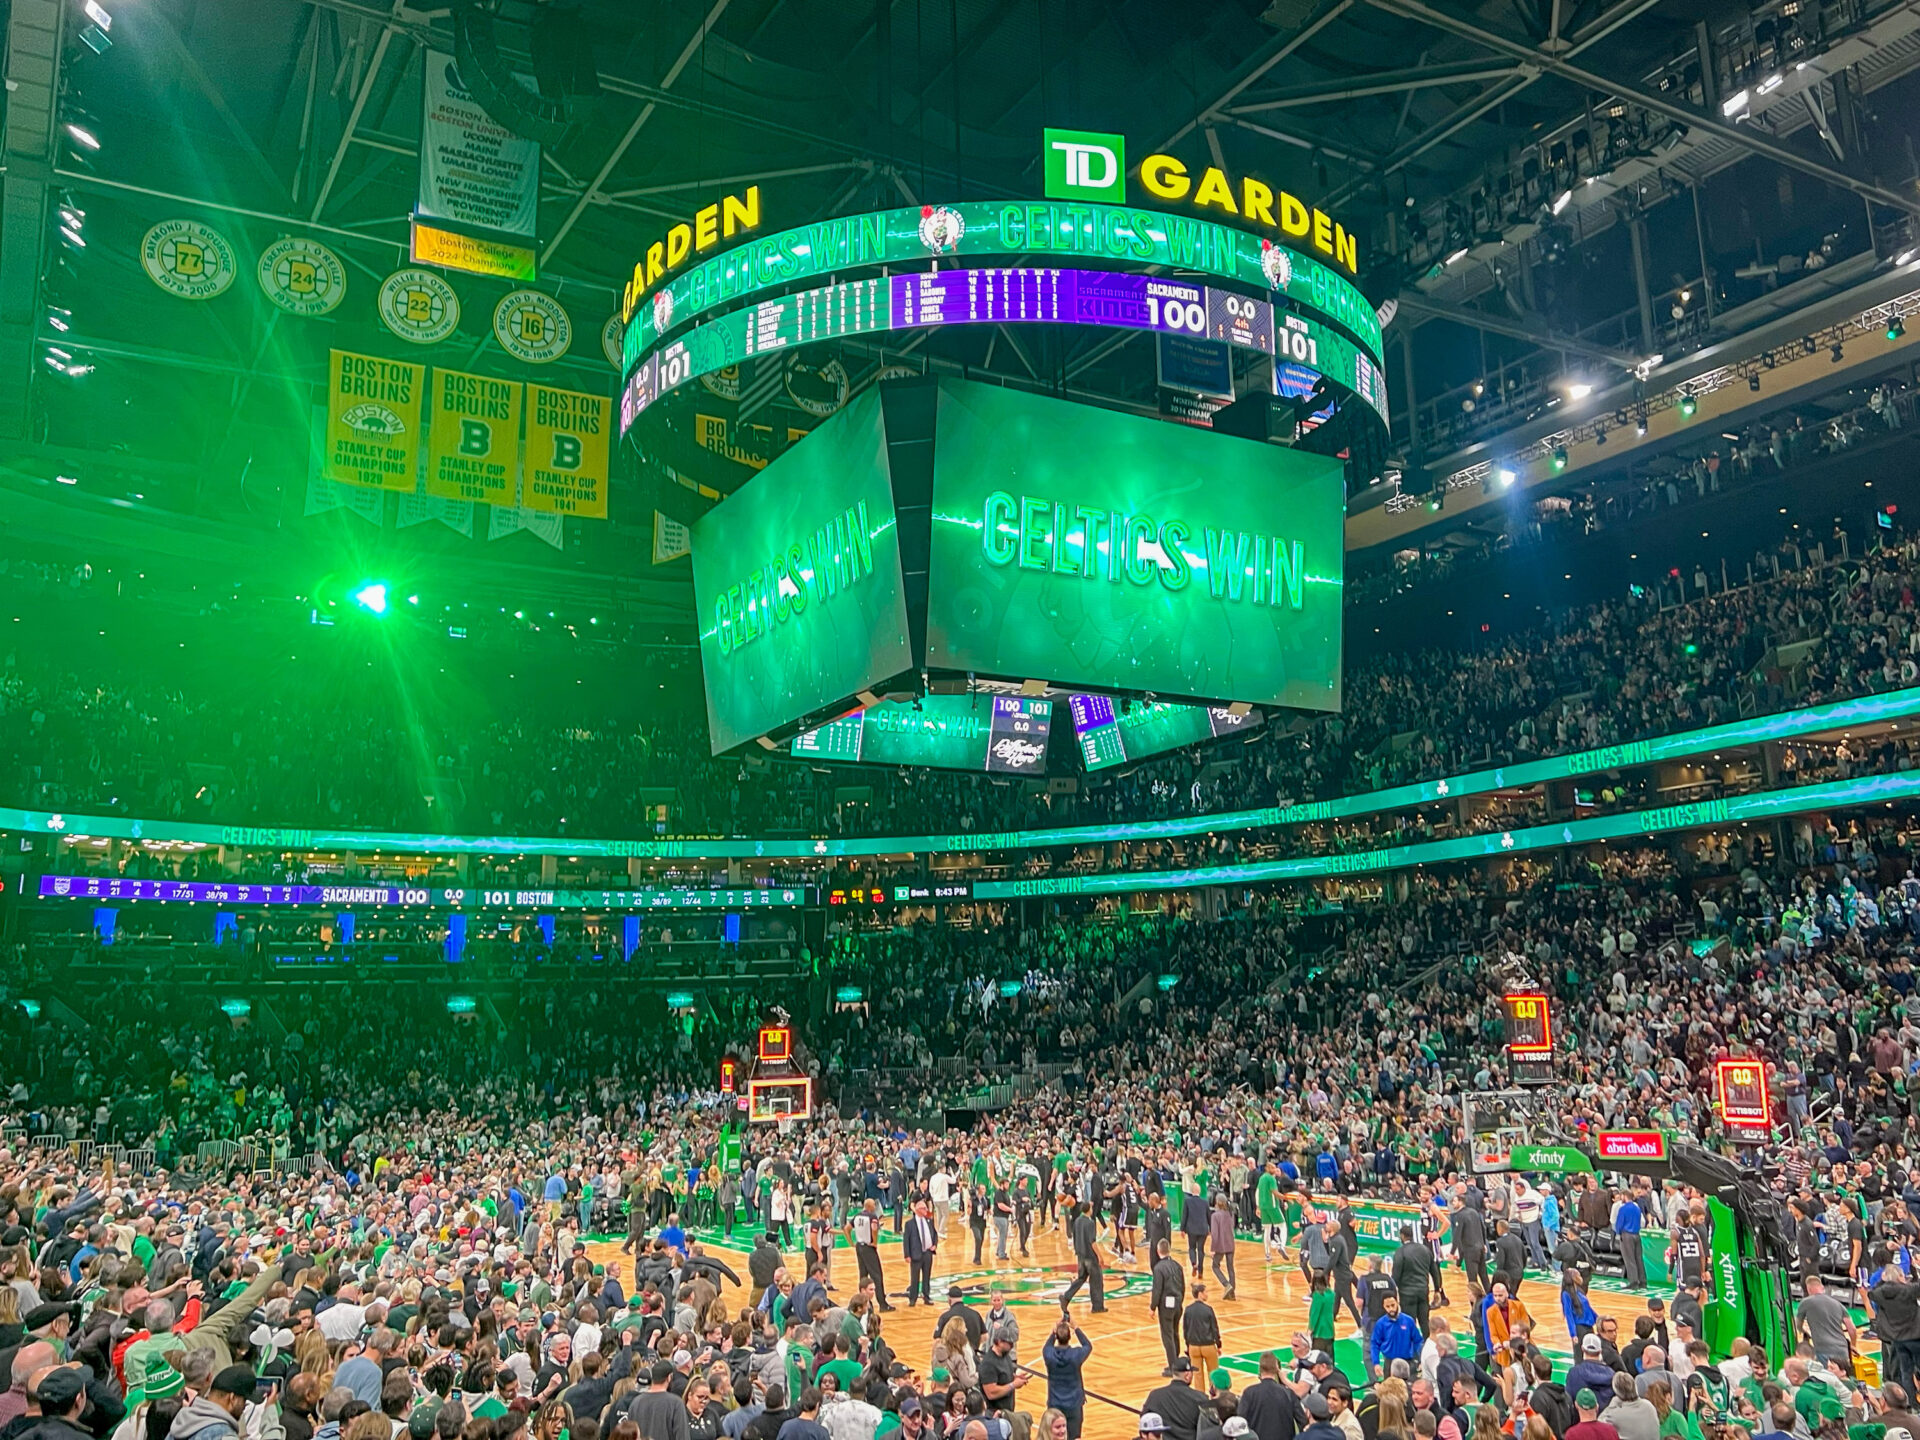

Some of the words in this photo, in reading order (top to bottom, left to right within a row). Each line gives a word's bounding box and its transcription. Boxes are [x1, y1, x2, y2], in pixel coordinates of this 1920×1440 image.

[463, 131, 502, 147] UCONN
[465, 141, 500, 157] MAINE
[481, 165, 519, 180] LOWELL
[1052, 142, 1117, 187] TD
[436, 175, 460, 187] NEW
[447, 199, 511, 219] PROVIDENCE
[1140, 154, 1357, 273] GARDEN
[146, 222, 183, 259] RAYMOND
[199, 228, 231, 274] BOURQUE
[440, 236, 474, 251] Boston
[477, 244, 514, 259] College
[1000, 204, 1153, 256] CELTICS
[1164, 216, 1237, 275] WIN
[178, 251, 202, 268] 77
[263, 242, 296, 271] TERENCE
[431, 249, 458, 260] 2024
[463, 254, 515, 271] Champions
[623, 185, 759, 325] GARDEN
[690, 232, 798, 311] CELTICS
[808, 214, 886, 271] WIN
[159, 274, 217, 296] 1979-2000
[292, 271, 312, 285] 24
[386, 273, 416, 293] WILLIE
[1146, 282, 1199, 301] SACRAMENTO
[410, 299, 429, 313] 22
[1226, 296, 1255, 319] 0.0
[1311, 265, 1377, 344] CELTICS
[499, 295, 521, 330] RICHARD
[536, 296, 567, 343] MIDDLETON
[1147, 298, 1205, 332] 100
[1235, 318, 1250, 329] 4th
[525, 317, 541, 336] 16
[1279, 327, 1317, 366] 101
[342, 355, 413, 385] BOSTON
[660, 351, 690, 390] 101
[340, 374, 411, 404] BRUINS
[444, 373, 511, 402] BOSTON
[443, 391, 510, 421] BRUINS
[538, 389, 601, 416] BOSTON
[345, 404, 404, 433] BOSTON
[537, 407, 600, 434] BRUINS
[459, 418, 492, 458] B
[337, 440, 384, 456] STANLEY
[386, 449, 406, 461] CUP
[552, 432, 583, 471] B
[334, 453, 406, 475] CHAMPIONS
[440, 456, 484, 472] STANLEY
[487, 464, 505, 476] CUP
[438, 469, 506, 490] CHAMPIONS
[534, 470, 576, 486] STANLEY
[578, 478, 597, 489] CUP
[533, 483, 597, 502] CHAMPIONS
[554, 499, 576, 512] 1941
[983, 490, 1191, 593] CELTICS
[1204, 525, 1305, 611] WIN
[714, 543, 808, 657] CELTICS
[807, 499, 874, 603] WIN
[999, 699, 1021, 712] 100
[1030, 703, 1048, 715] 101
[877, 709, 941, 736] CELTICS
[945, 716, 979, 739] WIN
[1014, 721, 1030, 732] 0.0
[1567, 747, 1620, 774] CELTICS
[1622, 741, 1651, 764] WIN
[1306, 802, 1331, 819] WIN
[1640, 806, 1695, 831] CELTICS
[1698, 800, 1729, 823] WIN
[222, 827, 277, 845] CELTICS
[280, 829, 311, 847] WIN
[947, 834, 993, 851] CELTICS
[995, 832, 1019, 848] WIN
[607, 841, 652, 857] CELTICS
[656, 841, 683, 856] WIN
[1324, 853, 1366, 873] CELTICS
[1367, 850, 1389, 868] WIN
[88, 886, 99, 895] 52
[110, 887, 120, 896] 21
[134, 888, 140, 897] 4
[154, 889, 160, 897] 6
[172, 889, 194, 898] 17/51
[206, 891, 228, 900] 38/98
[238, 891, 248, 900] 39
[284, 892, 290, 901] 5
[323, 888, 389, 903] SACRAMENTO
[397, 890, 427, 904] 100
[445, 889, 464, 900] 0.0
[911, 889, 929, 897] Bank
[935, 888, 953, 897] 9:43
[954, 887, 967, 896] PM
[1013, 878, 1056, 896] CELTICS
[1058, 877, 1082, 893] WIN
[484, 891, 510, 905] 101
[516, 891, 554, 905] BOSTON
[744, 896, 752, 904] 25
[760, 896, 769, 904] 52
[1516, 1000, 1537, 1019] 0.0
[1524, 1052, 1551, 1061] TISSOT
[1607, 1143, 1627, 1154] abu
[1628, 1142, 1656, 1154] dhabi
[1529, 1149, 1565, 1168] xfinity
[1363, 1220, 1379, 1235] THE
[1681, 1242, 1700, 1257] 23
[1718, 1252, 1739, 1309] xfinity
